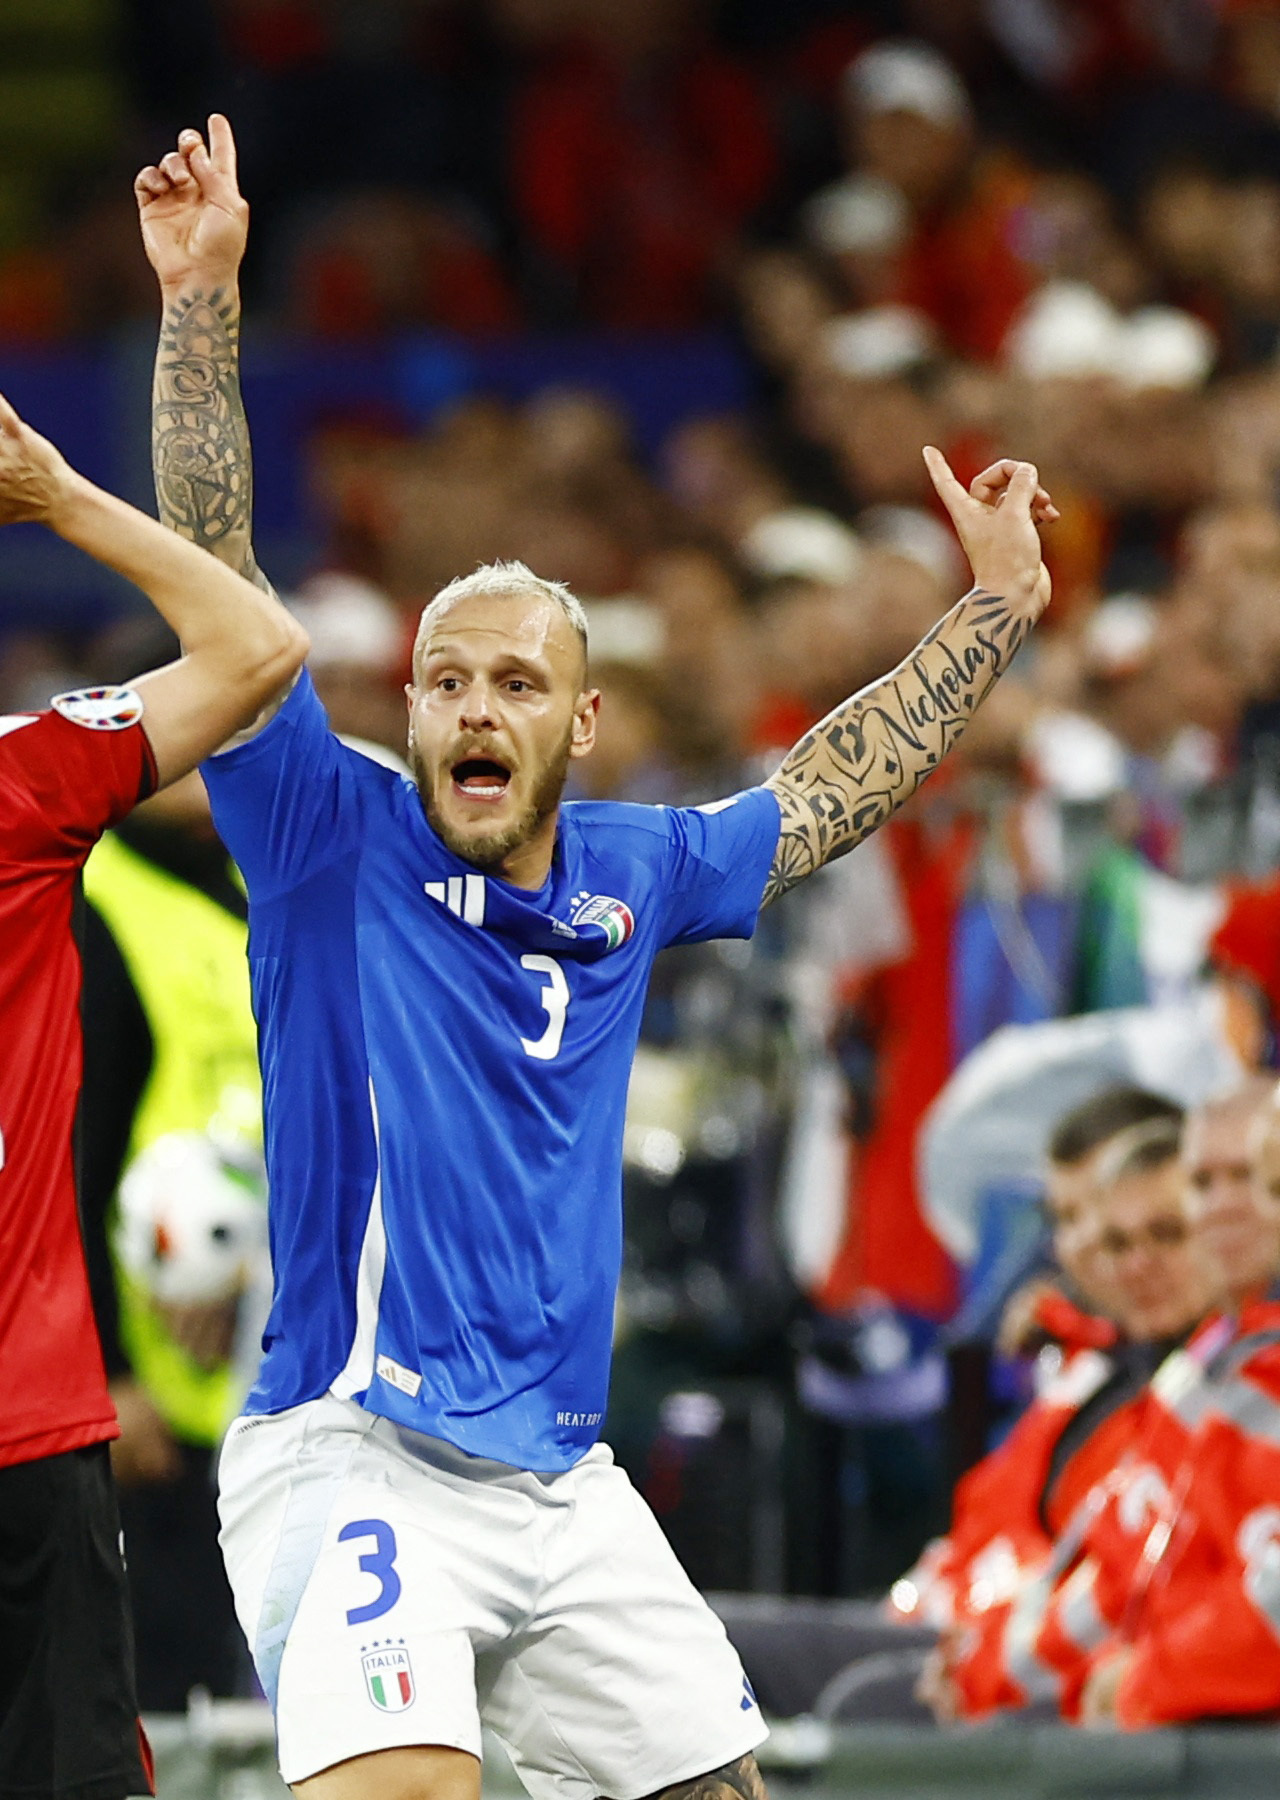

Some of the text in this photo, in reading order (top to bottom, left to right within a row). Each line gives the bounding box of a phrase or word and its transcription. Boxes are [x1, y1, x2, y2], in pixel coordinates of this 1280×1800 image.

[859, 630, 1003, 790] Nicholas
[520, 953, 570, 1061] 3
[337, 1518, 402, 1627] 3
[366, 1653, 406, 1671] ITALIA
